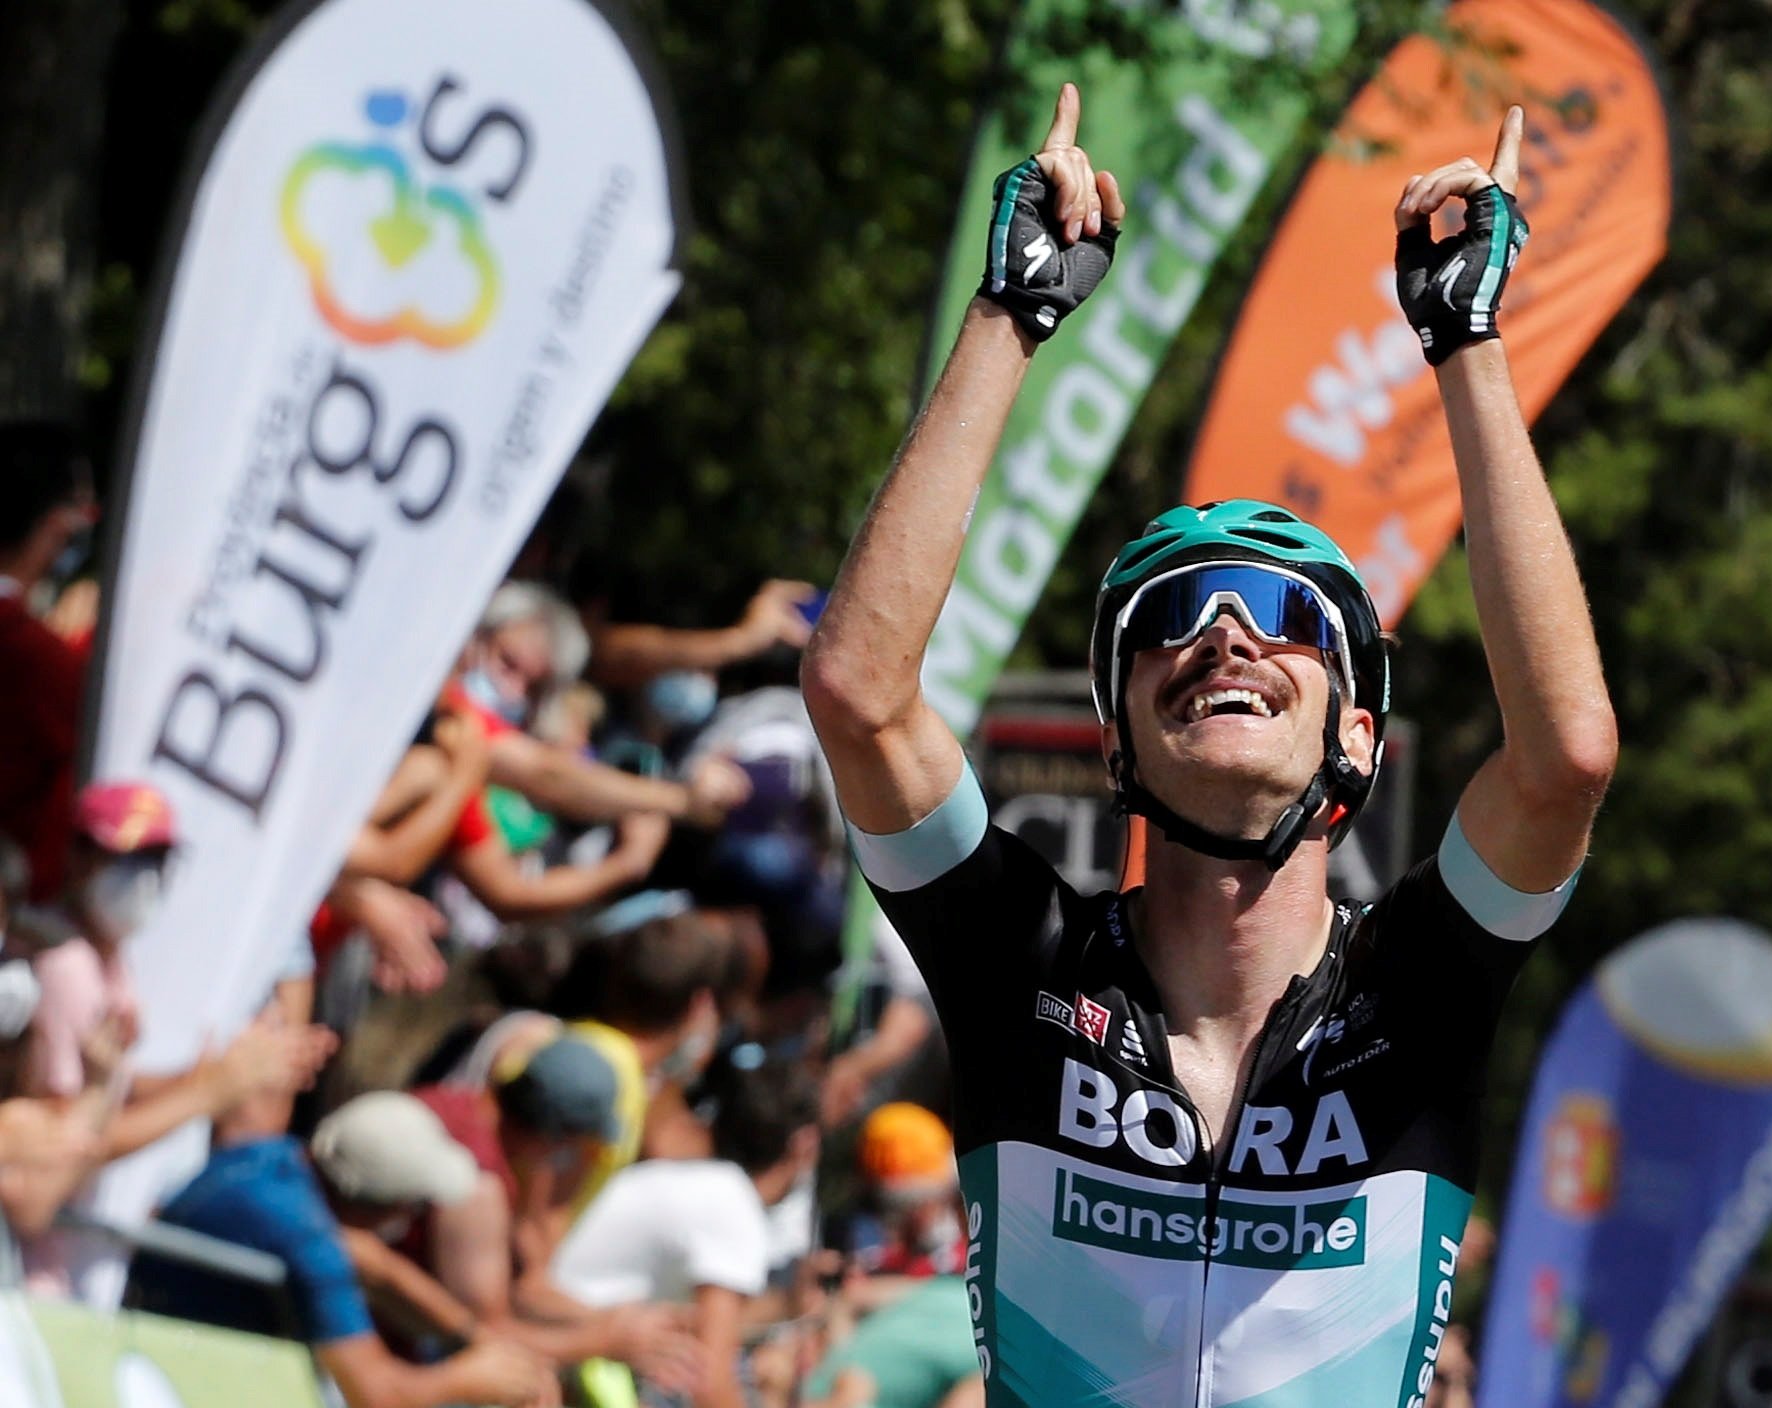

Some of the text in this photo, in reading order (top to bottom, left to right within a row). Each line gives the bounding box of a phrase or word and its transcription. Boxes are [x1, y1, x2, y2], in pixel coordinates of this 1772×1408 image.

[1040, 997, 1070, 1023] BIKE
[1059, 1058, 1370, 1176] BORA
[1062, 1188, 1358, 1254] hansgrohe
